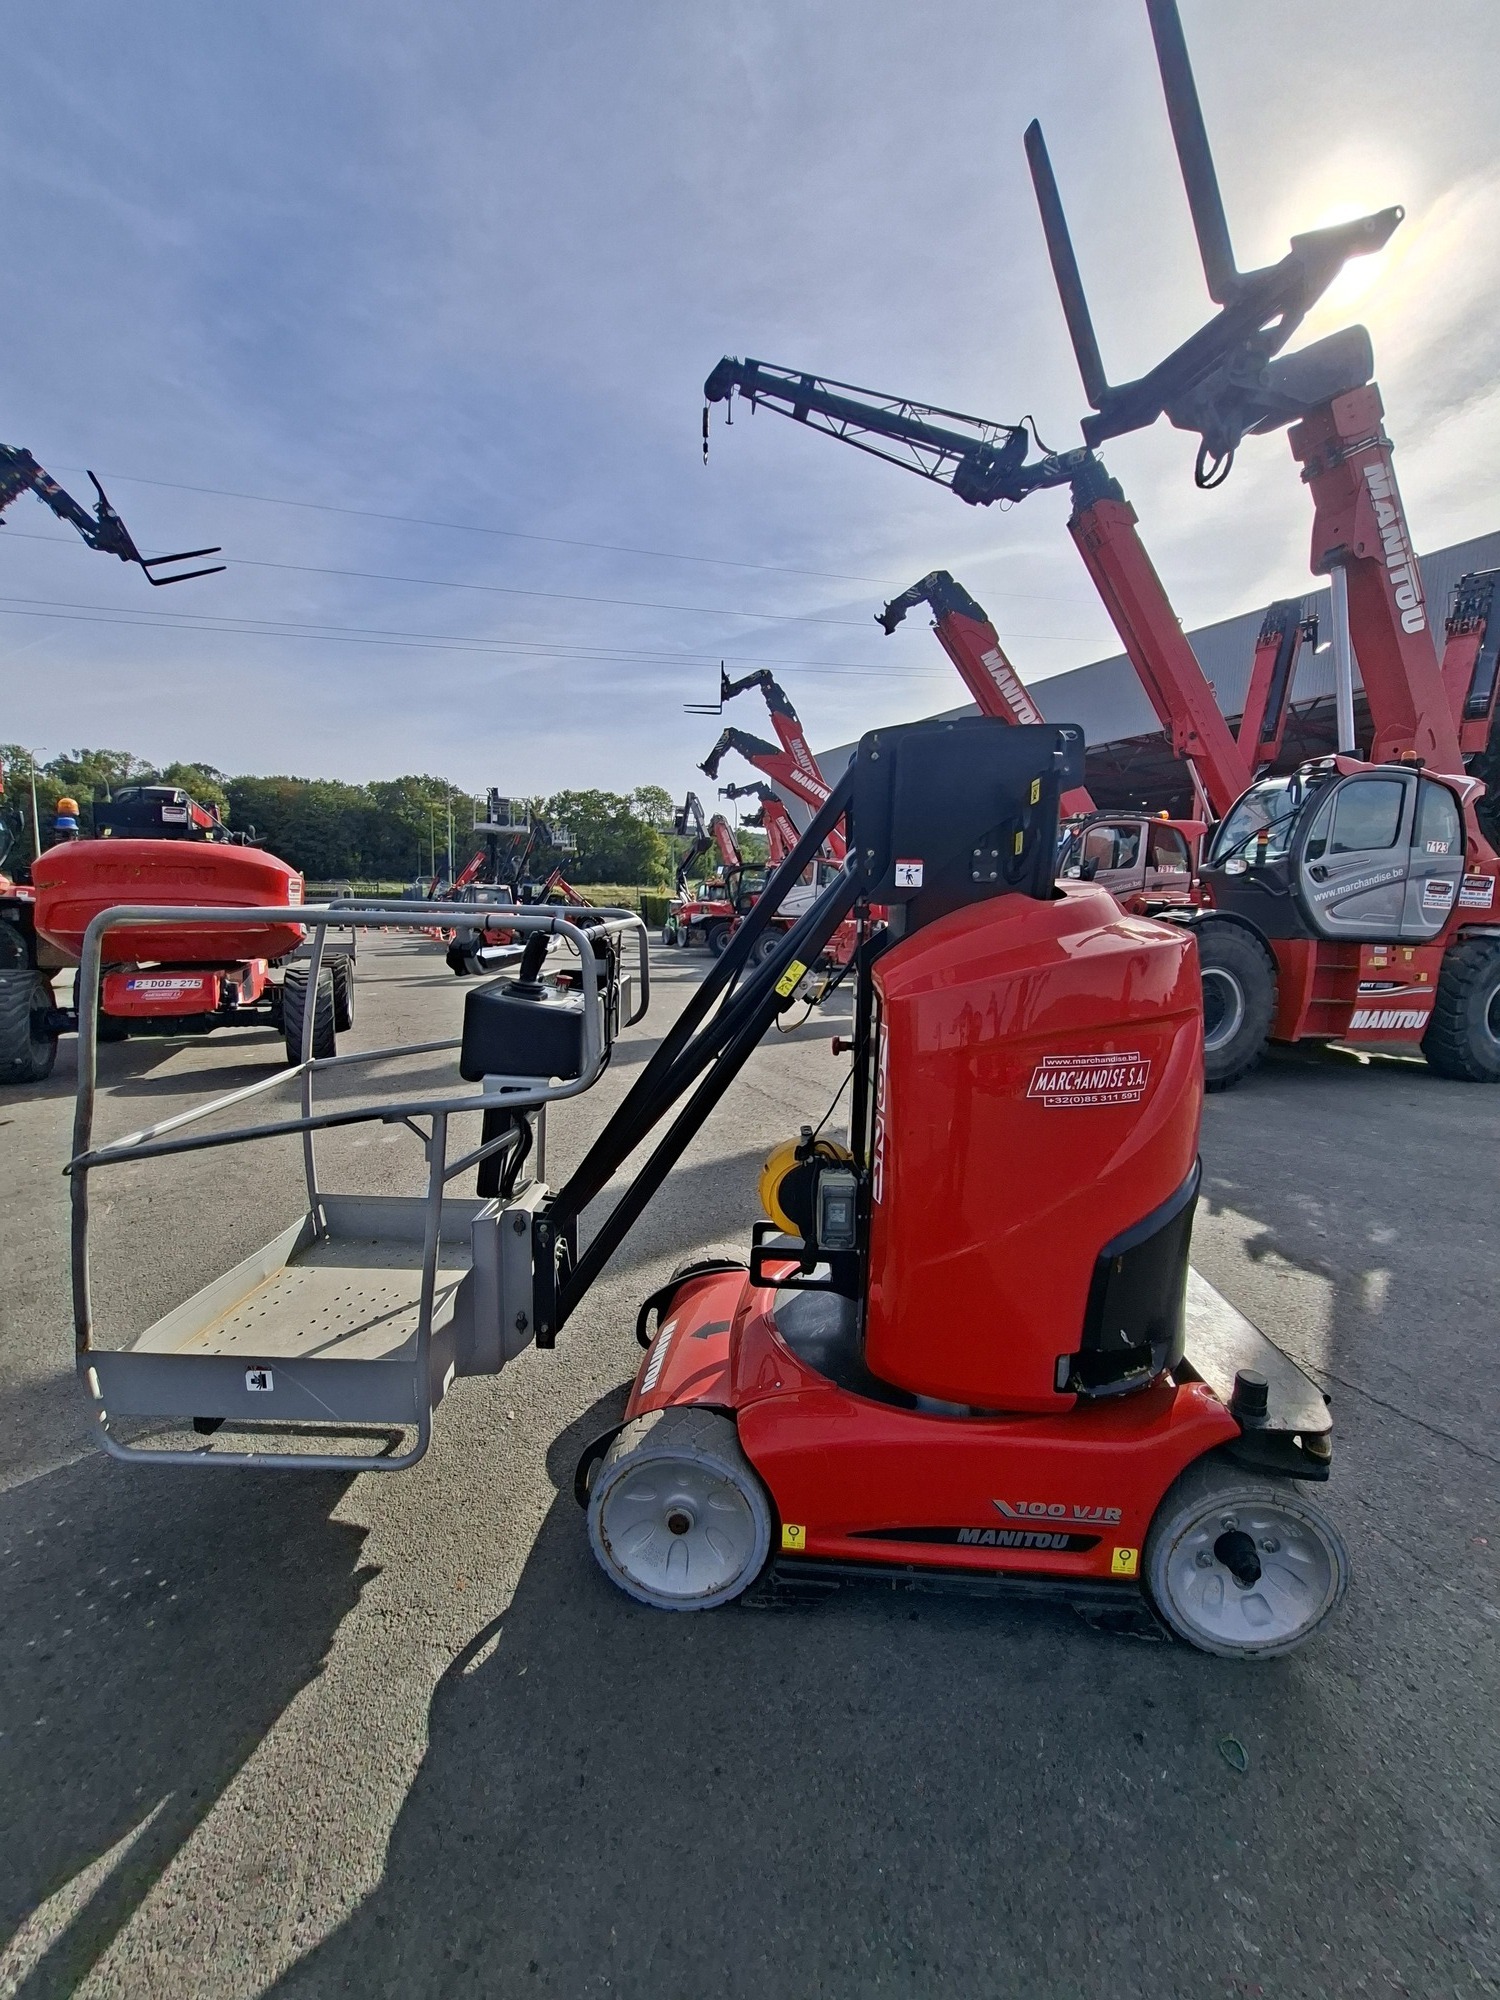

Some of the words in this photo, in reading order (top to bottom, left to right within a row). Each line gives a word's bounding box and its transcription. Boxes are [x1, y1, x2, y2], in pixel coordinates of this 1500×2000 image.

[1363, 462, 1425, 634] MANITOU
[791, 738, 817, 777] MANIT
[1428, 841, 1448, 853] 7123
[1314, 868, 1404, 902] www.marchandise.be
[1349, 1010, 1431, 1029] MANITOU
[1046, 1055, 1138, 1066] www.marchandise.be
[1035, 1068, 1126, 1091] MARCHANDISE
[1047, 1096, 1098, 1105] +32(0)85
[1100, 1094, 1119, 1102] 311
[1121, 1092, 1138, 1100] 591
[640, 1317, 680, 1395] MANITOU
[1015, 1501, 1067, 1517] 100
[1073, 1505, 1123, 1521] VJR
[957, 1528, 1070, 1549] MANITOU
